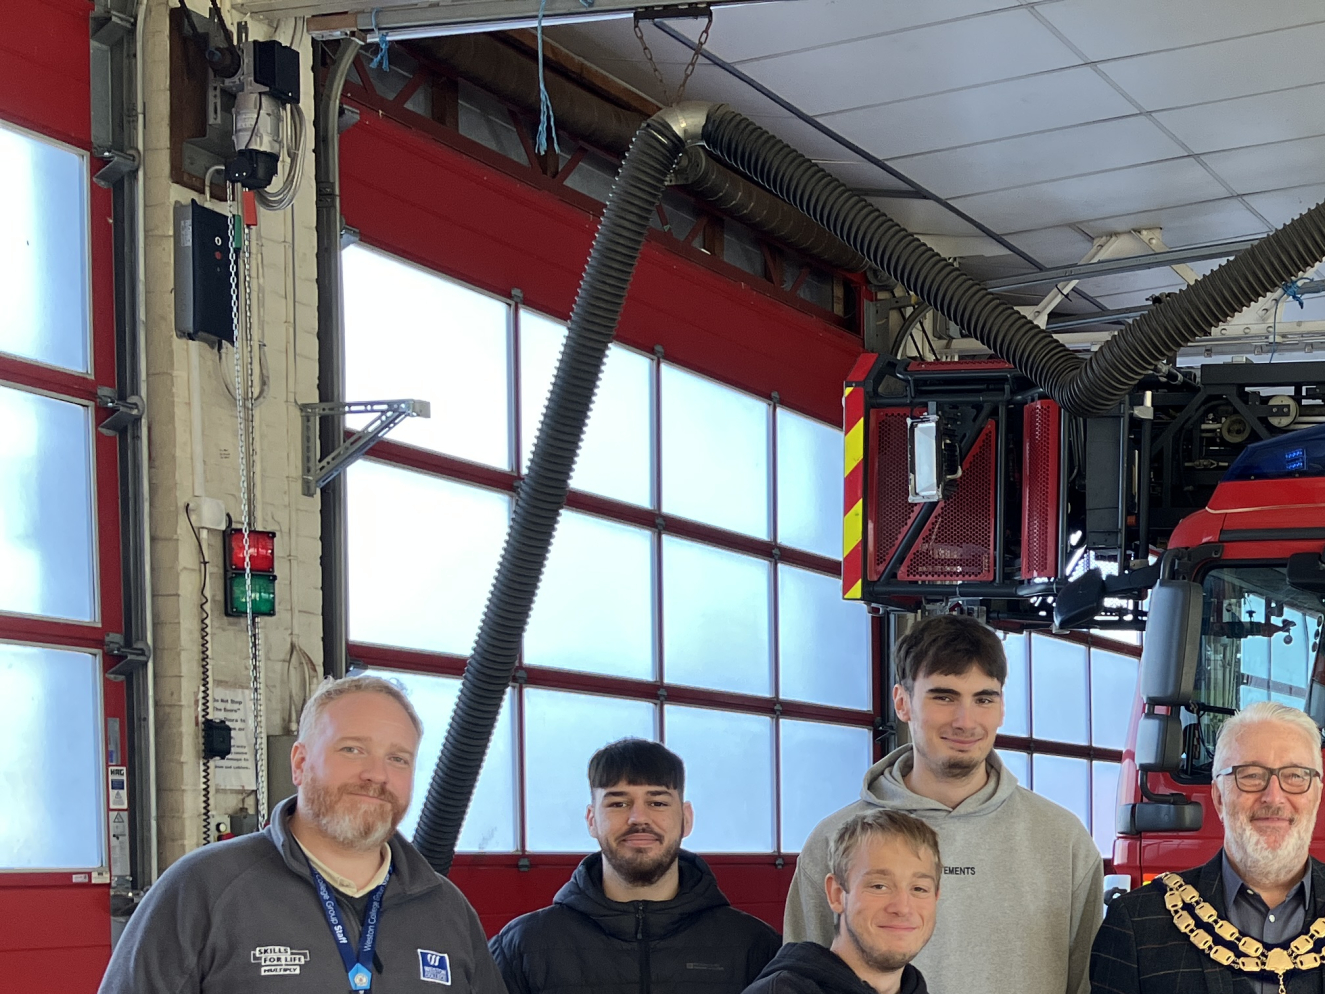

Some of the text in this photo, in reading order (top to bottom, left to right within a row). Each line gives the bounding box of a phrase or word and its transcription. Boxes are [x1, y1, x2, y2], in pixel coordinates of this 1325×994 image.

[325, 901, 339, 924] Group
[334, 925, 348, 943] Staff
[368, 901, 380, 924] College
[363, 925, 375, 952] Weston
